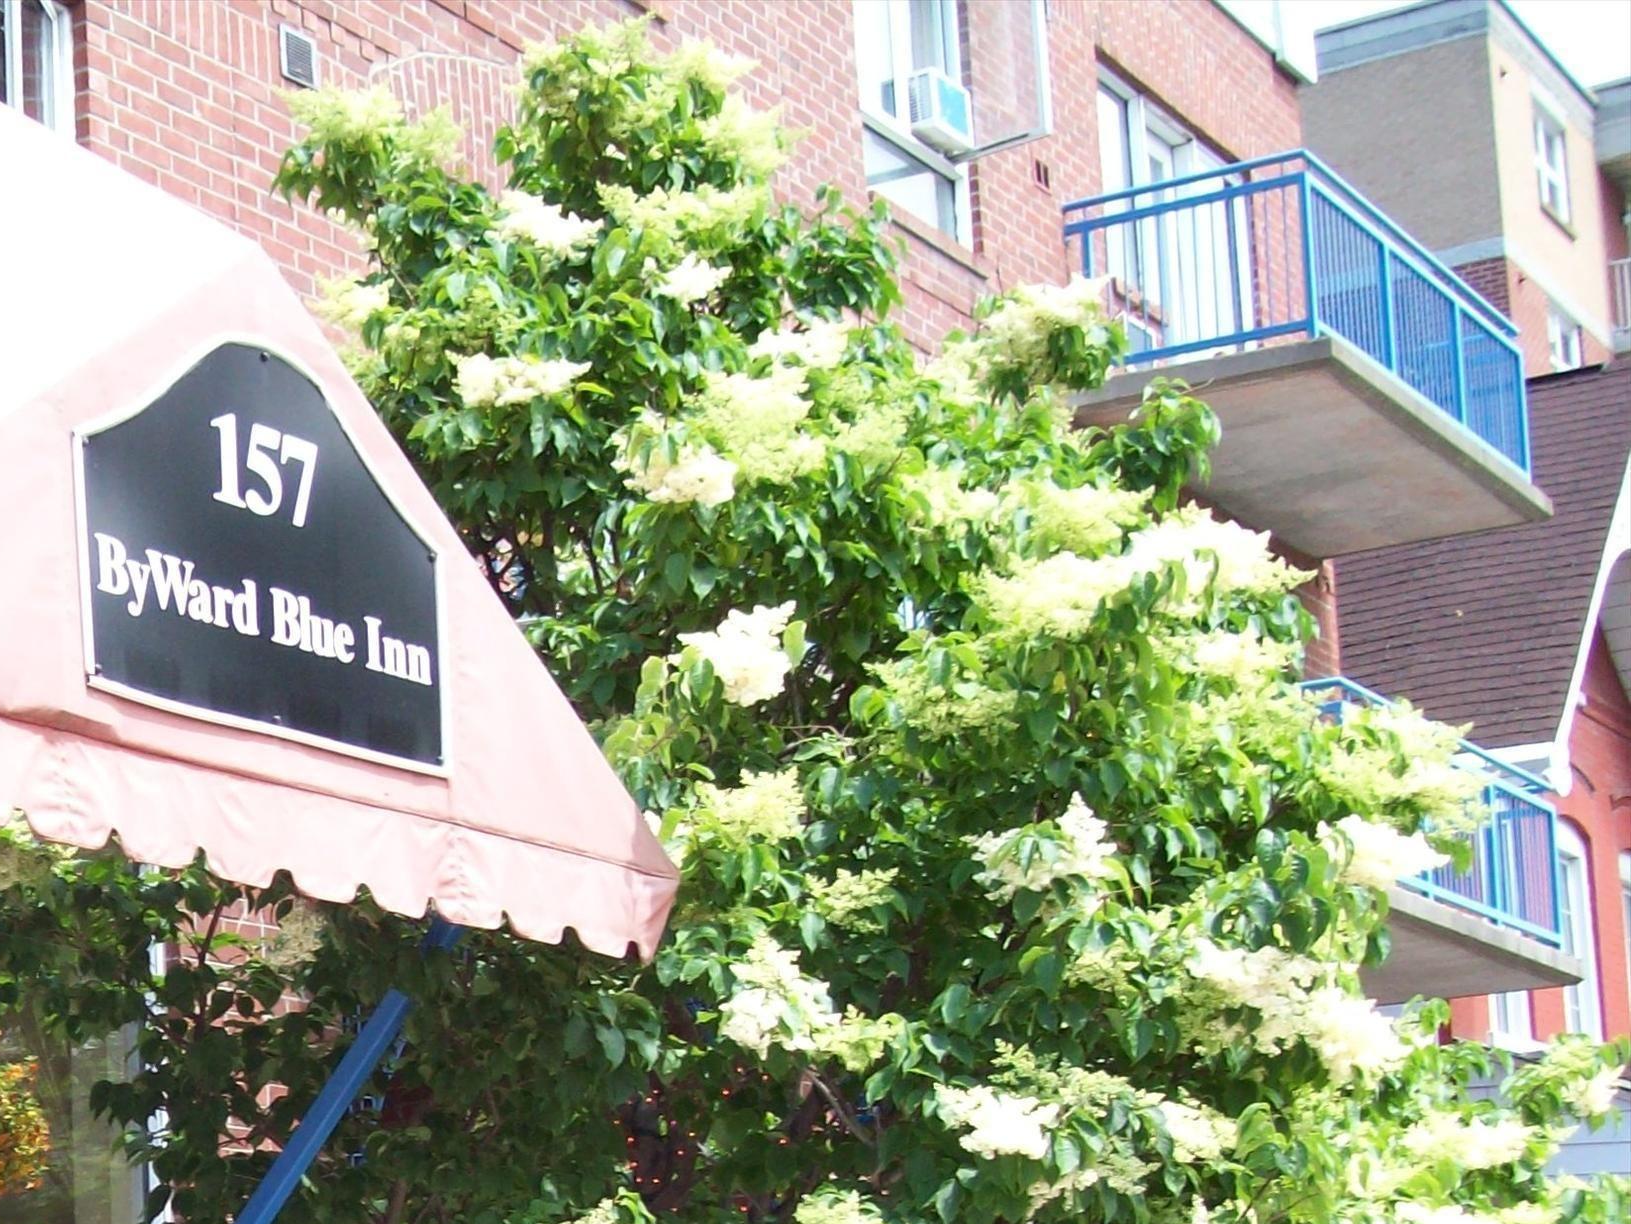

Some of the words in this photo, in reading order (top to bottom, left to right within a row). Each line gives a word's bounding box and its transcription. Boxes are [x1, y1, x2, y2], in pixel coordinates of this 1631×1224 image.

[210, 413, 318, 527] 157
[94, 533, 260, 636] ByWard
[269, 587, 355, 663] Blue
[363, 616, 432, 686] Inn
